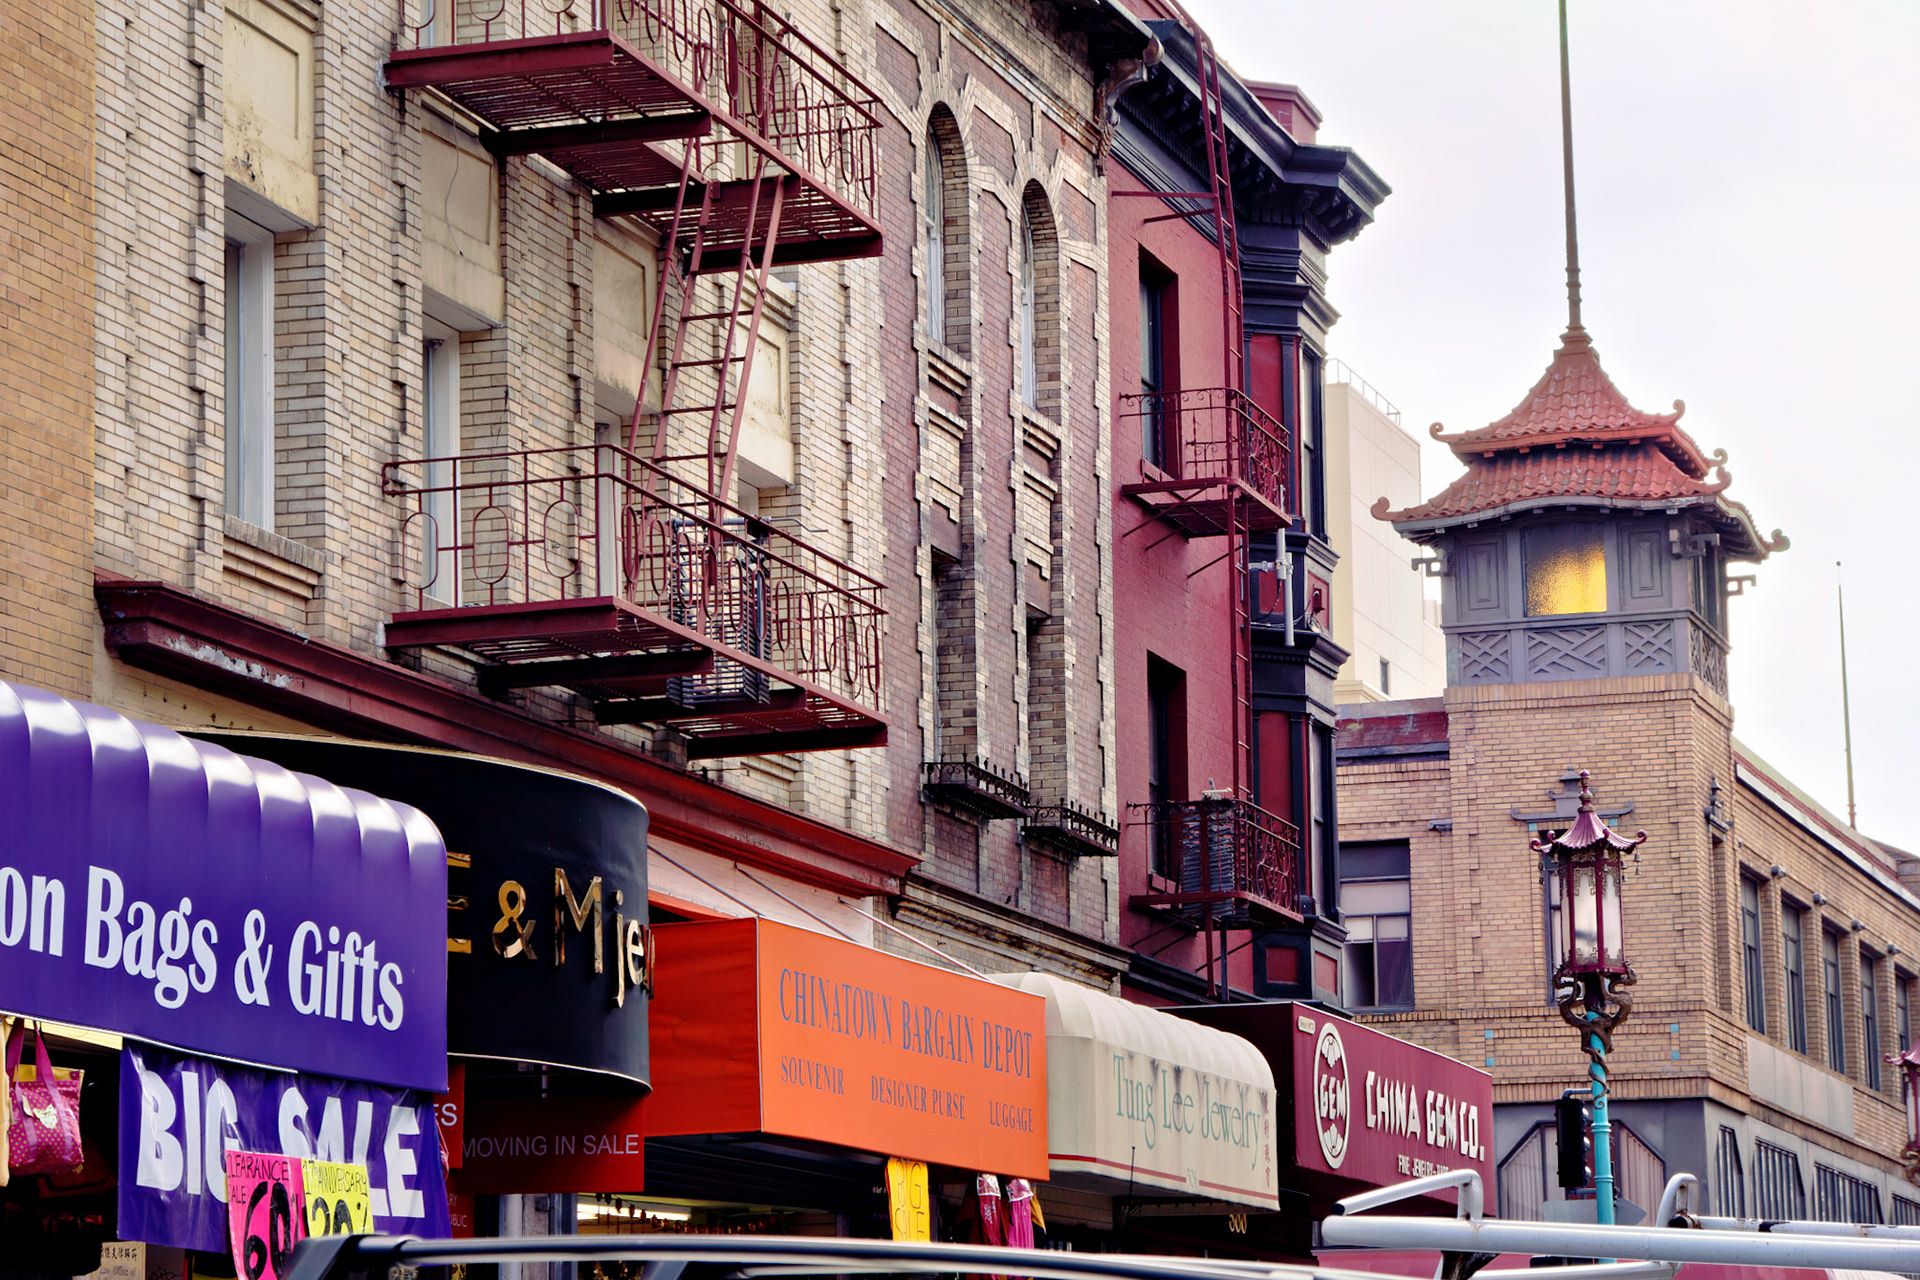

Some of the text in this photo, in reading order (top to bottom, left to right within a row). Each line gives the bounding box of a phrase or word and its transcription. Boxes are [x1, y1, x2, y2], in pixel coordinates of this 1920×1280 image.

[84, 865, 218, 1010] Bags
[233, 909, 274, 1007] &
[288, 921, 404, 1031] Gifts
[492, 880, 537, 960] &
[779, 968, 1033, 1079] CHINATOWN BARGAIN DEPOT
[781, 1055, 1034, 1133] SOUVENIR DESIGNER PURSE LUGGAGE
[1113, 1054, 1154, 1150] Tung
[1162, 1069, 1195, 1135] Lee
[1202, 1081, 1260, 1170] Jewelry
[1319, 1073, 1348, 1121] GEM
[1365, 1070, 1485, 1162] CHINA GEM CO.
[136, 1067, 425, 1219] BIG SALE
[226, 1153, 290, 1181] CLEARANCE
[317, 1165, 368, 1197] ANNIVERSARY
[461, 1134, 639, 1158] MOVING IN SALE
[227, 1185, 247, 1205] SALE
